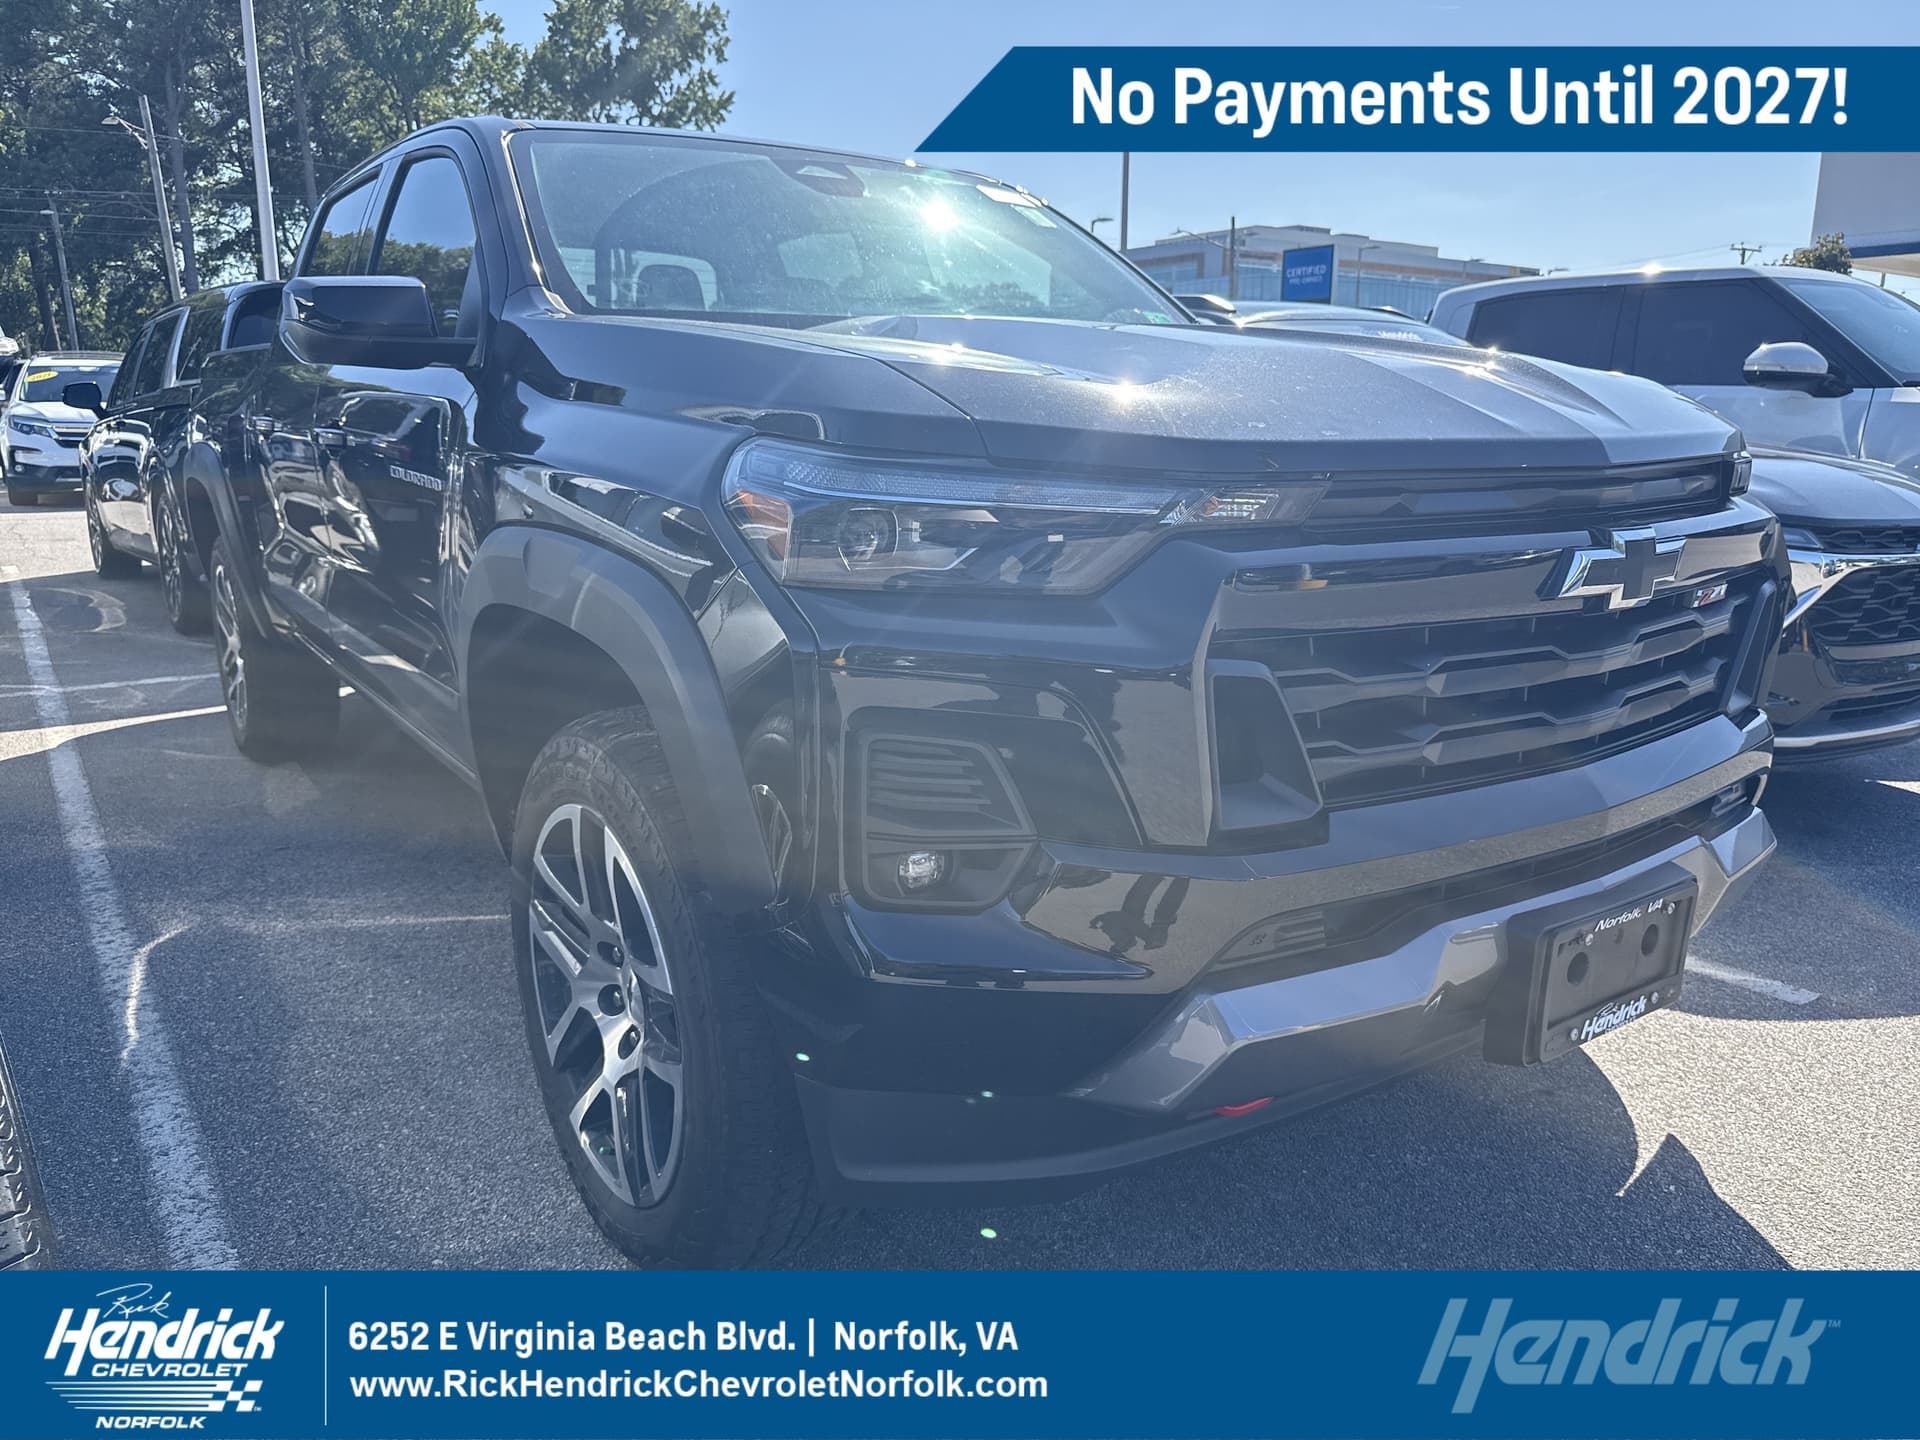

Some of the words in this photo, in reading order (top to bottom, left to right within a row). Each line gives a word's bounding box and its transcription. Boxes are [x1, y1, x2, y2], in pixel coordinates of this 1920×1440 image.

[1286, 264, 1327, 278] CERTIFIED
[1647, 898, 1663, 913] VA
[1581, 995, 1648, 1041] Hendrick
